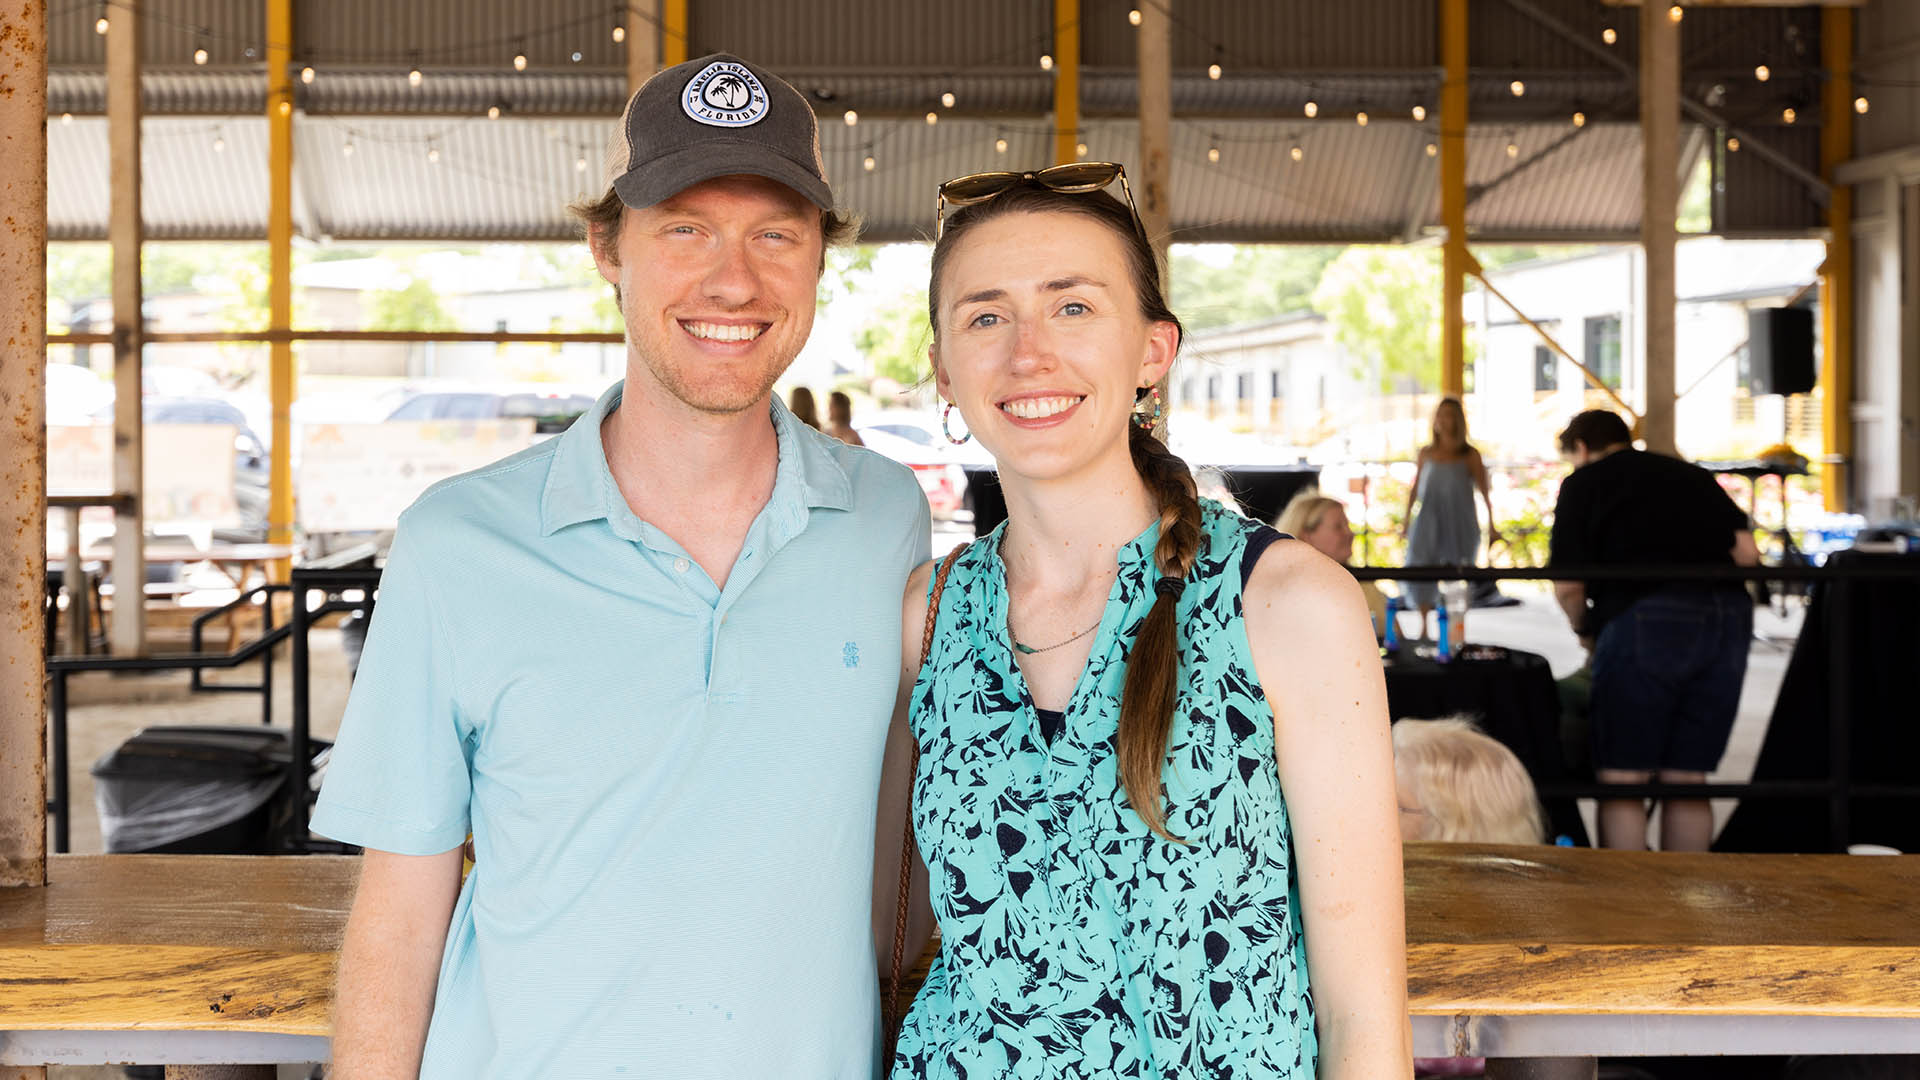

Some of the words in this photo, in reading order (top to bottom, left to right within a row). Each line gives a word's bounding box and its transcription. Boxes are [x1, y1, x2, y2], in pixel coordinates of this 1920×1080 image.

[692, 65, 724, 93] AMELIA
[727, 65, 759, 91] ISLAND
[698, 108, 758, 120] FLORIDA
